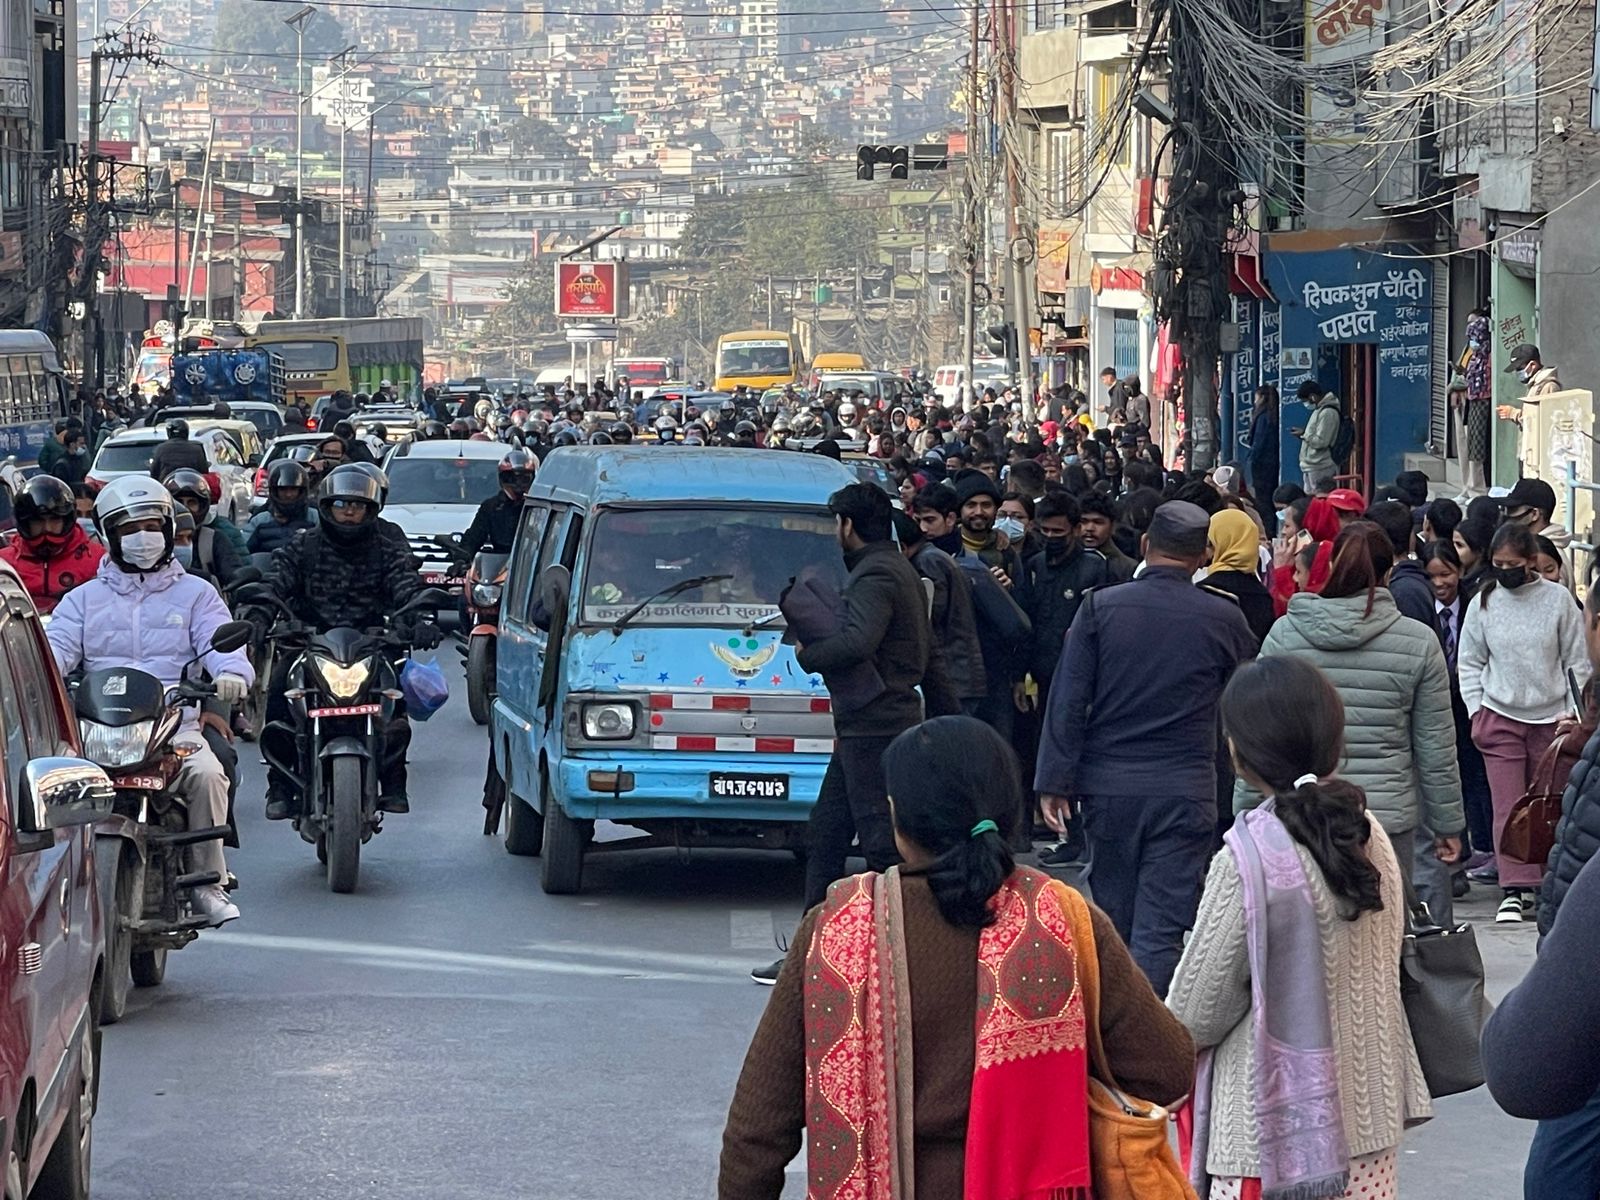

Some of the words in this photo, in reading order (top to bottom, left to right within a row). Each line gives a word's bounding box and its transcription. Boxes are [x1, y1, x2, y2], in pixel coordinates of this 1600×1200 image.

[1303, 281, 1350, 309] दिपक
[1351, 281, 1381, 310] सुन
[1383, 269, 1426, 299] चाँदी
[1318, 310, 1377, 341] पसल
